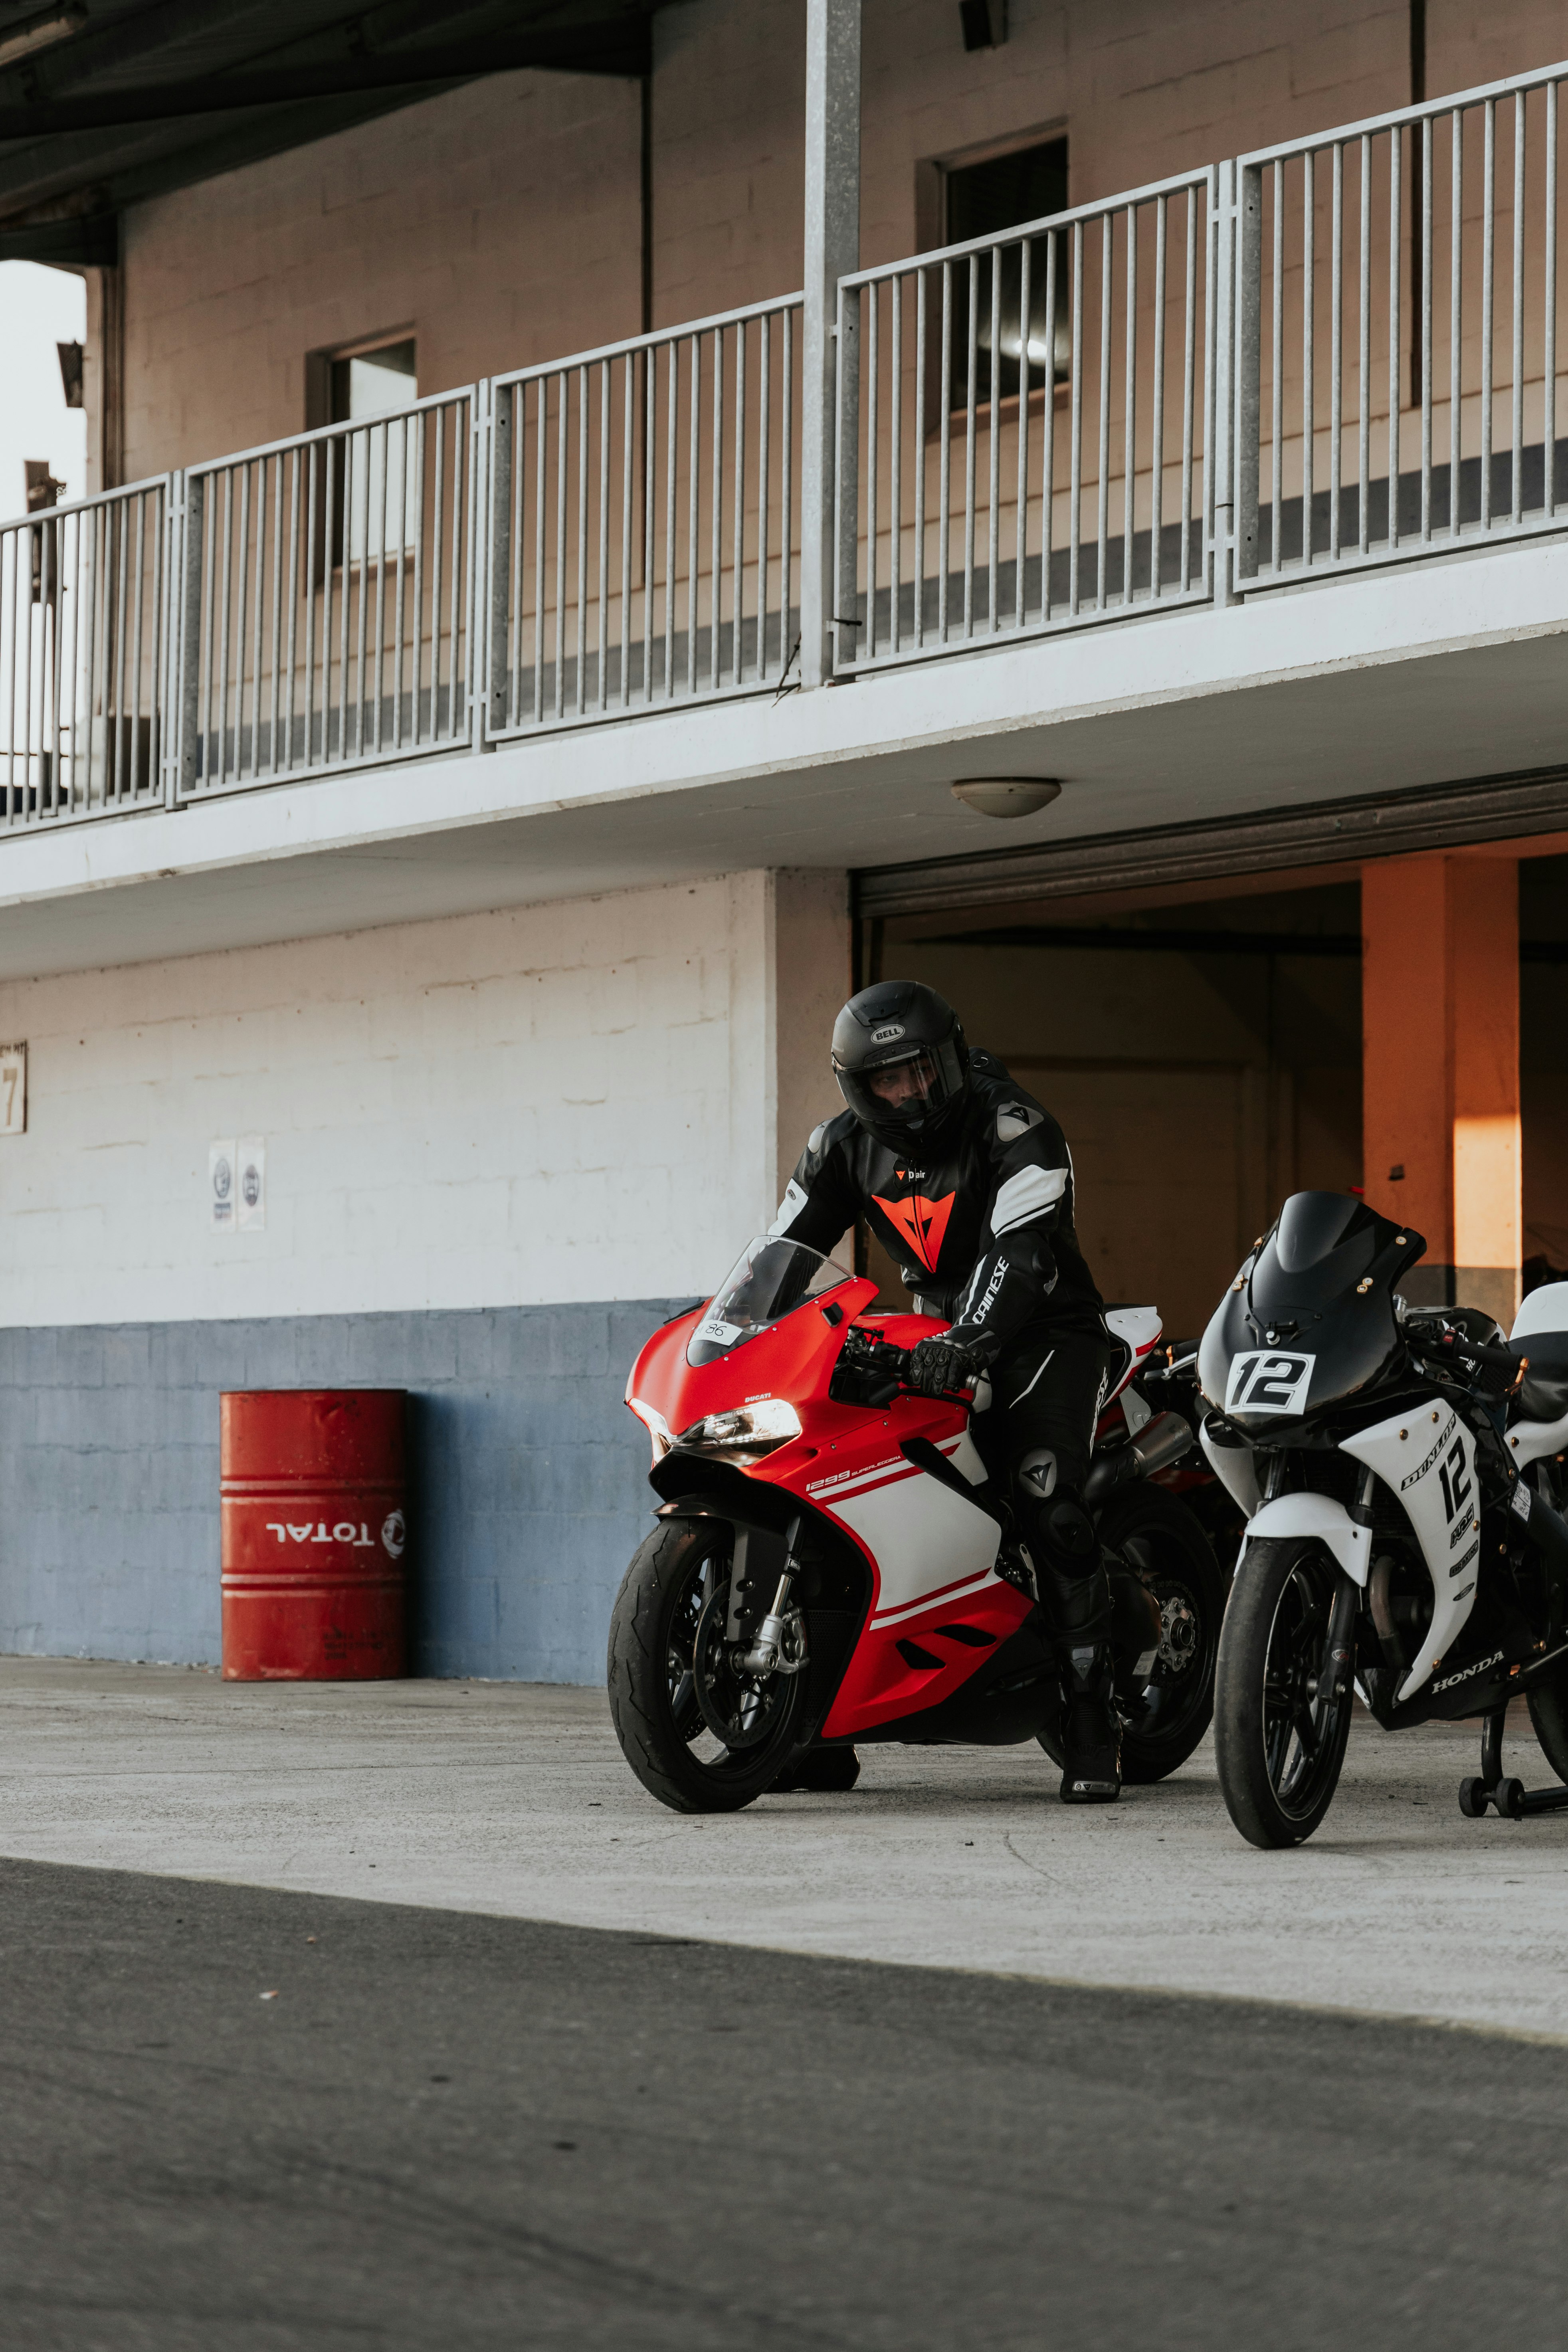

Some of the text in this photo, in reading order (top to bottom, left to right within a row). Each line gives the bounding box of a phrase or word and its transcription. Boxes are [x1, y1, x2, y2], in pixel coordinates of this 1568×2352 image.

[876, 1028, 901, 1041] BELL
[3, 1068, 17, 1126] 7
[972, 1256, 1009, 1324] DAINESE
[705, 1324, 727, 1336] 86
[744, 1392, 771, 1403] DUCATI
[1229, 1354, 1309, 1410] 12
[806, 1455, 901, 1492] 1299 SUPERLEGGERA
[1403, 1418, 1455, 1490] DUNLOP
[1439, 1435, 1471, 1524] 12
[266, 1522, 375, 1547] TOTAL
[1451, 1504, 1474, 1548] HRC
[1451, 1542, 1478, 1574] BRAKING
[1432, 1651, 1504, 1694] HONDA
